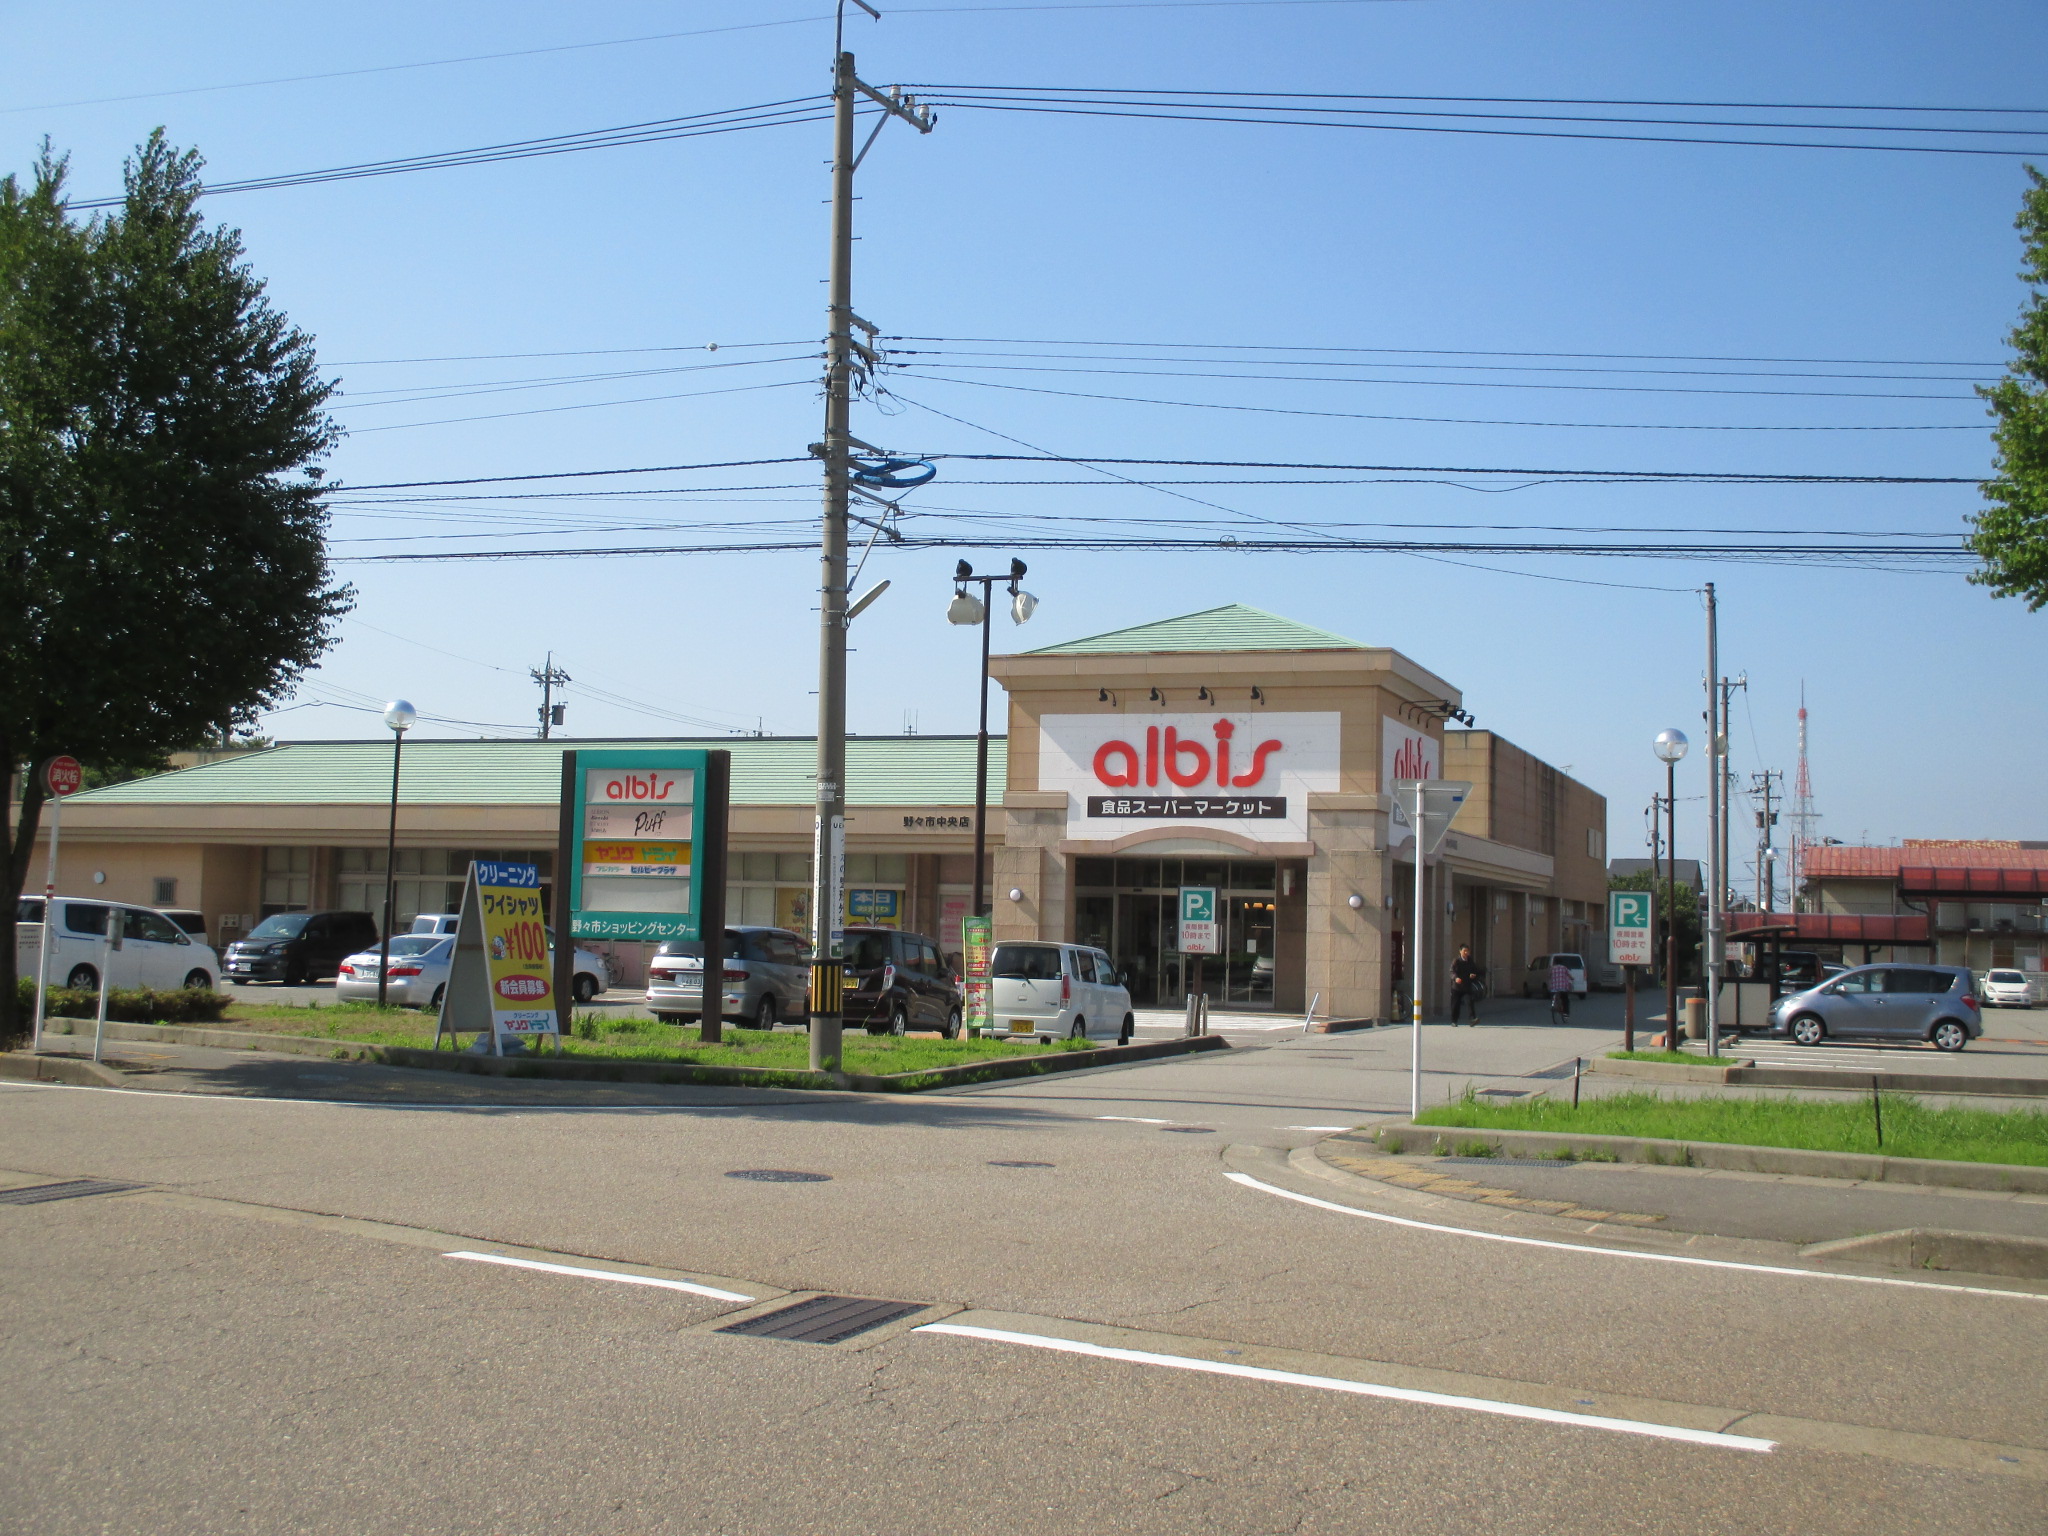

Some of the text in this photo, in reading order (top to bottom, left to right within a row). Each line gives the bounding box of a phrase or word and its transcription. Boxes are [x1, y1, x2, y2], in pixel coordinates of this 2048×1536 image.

[1093, 717, 1283, 788] albis
[52, 767, 78, 783] 消火栓
[606, 772, 674, 800] albis
[1101, 798, 1272, 816] 食品スーパーマーケット
[634, 809, 667, 837] Puff
[903, 816, 970, 828] 野々市中央店
[479, 864, 536, 887] クリーニング
[483, 894, 539, 916] ワイシャツ
[854, 892, 891, 903] 本日
[1186, 894, 1204, 917] P
[1618, 898, 1638, 924] P
[571, 919, 697, 936] 野々市ショッピングセンター
[504, 921, 546, 962] ¥100
[1186, 943, 1206, 951] albis
[1619, 953, 1641, 961] albis
[500, 979, 546, 995] 新会員募集
[513, 1011, 539, 1019] クリーニング
